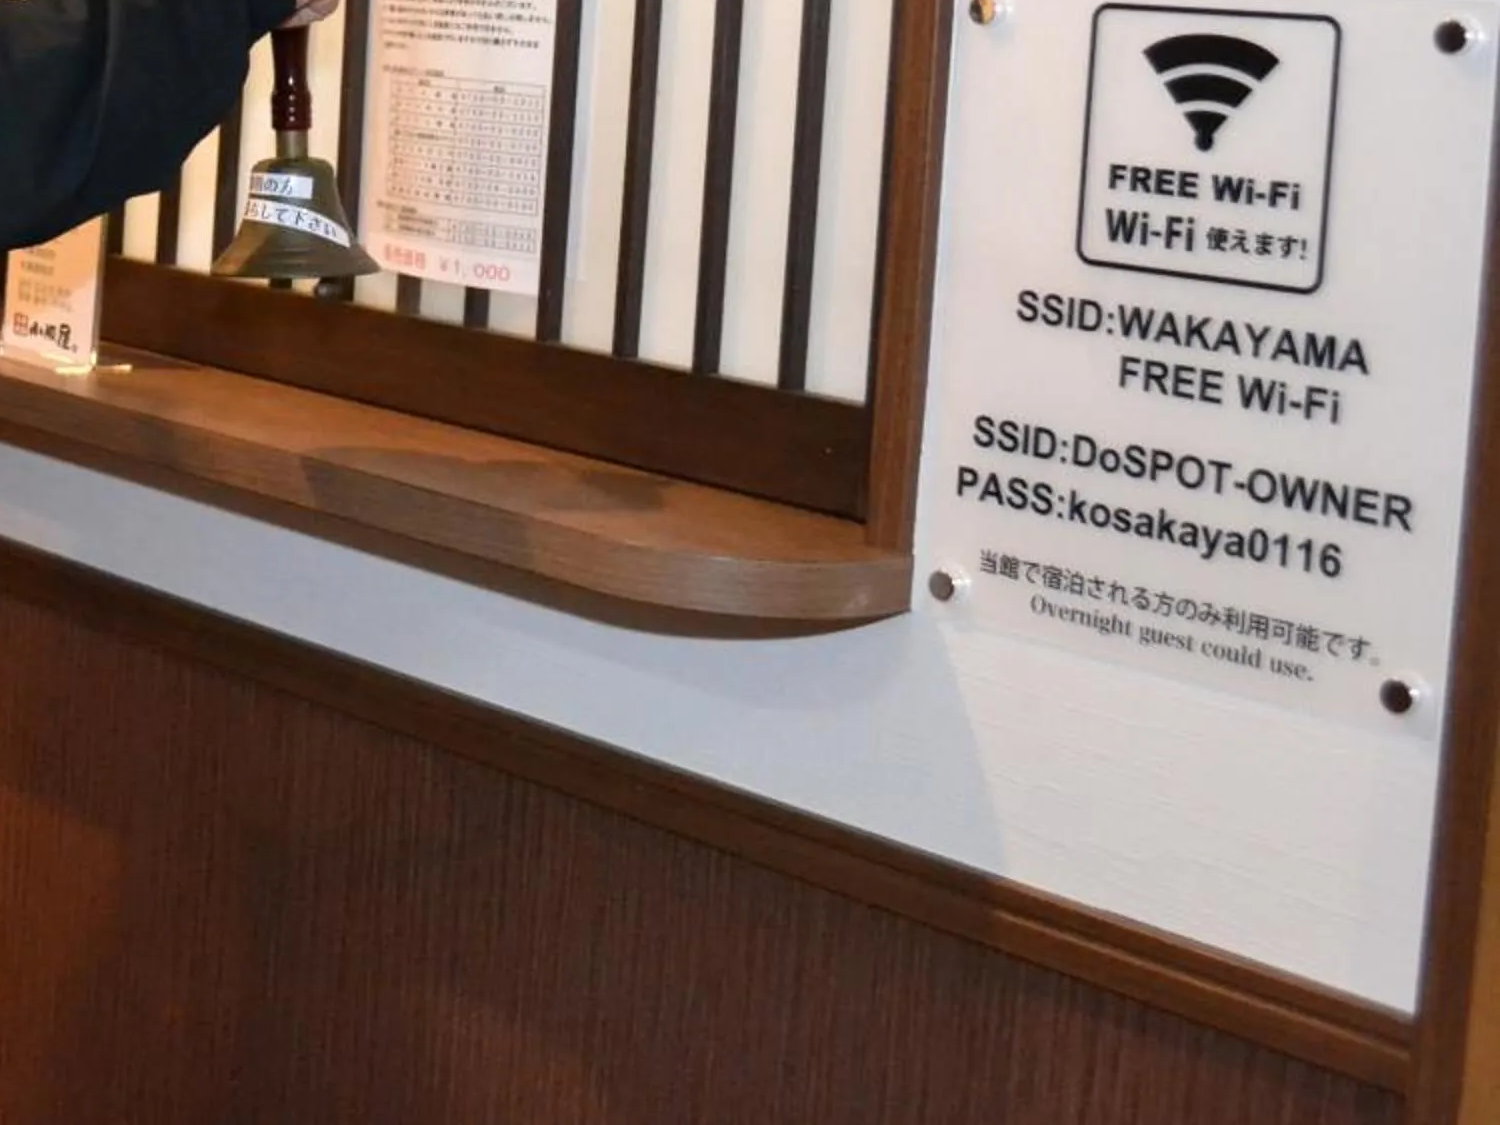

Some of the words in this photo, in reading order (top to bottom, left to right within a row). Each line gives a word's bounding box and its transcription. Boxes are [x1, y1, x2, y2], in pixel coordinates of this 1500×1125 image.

[244, 200, 338, 238] らして下さい
[1108, 164, 1199, 200] FREE
[1212, 174, 1300, 211] Wi-Fi
[1105, 208, 1196, 253] Wi-Fi
[1016, 290, 1370, 376] SSID:WAKAYAMA
[1119, 356, 1224, 405] FREE
[1237, 373, 1342, 425] Wi-Fi
[972, 415, 1416, 532] SSID:DoSPOT-OWNER
[956, 466, 1343, 579] PASS:kosakaya0116
[1030, 592, 1133, 638] Overnight
[1138, 622, 1195, 654] guest
[1200, 638, 1263, 670] could
[1269, 656, 1315, 682] use.
